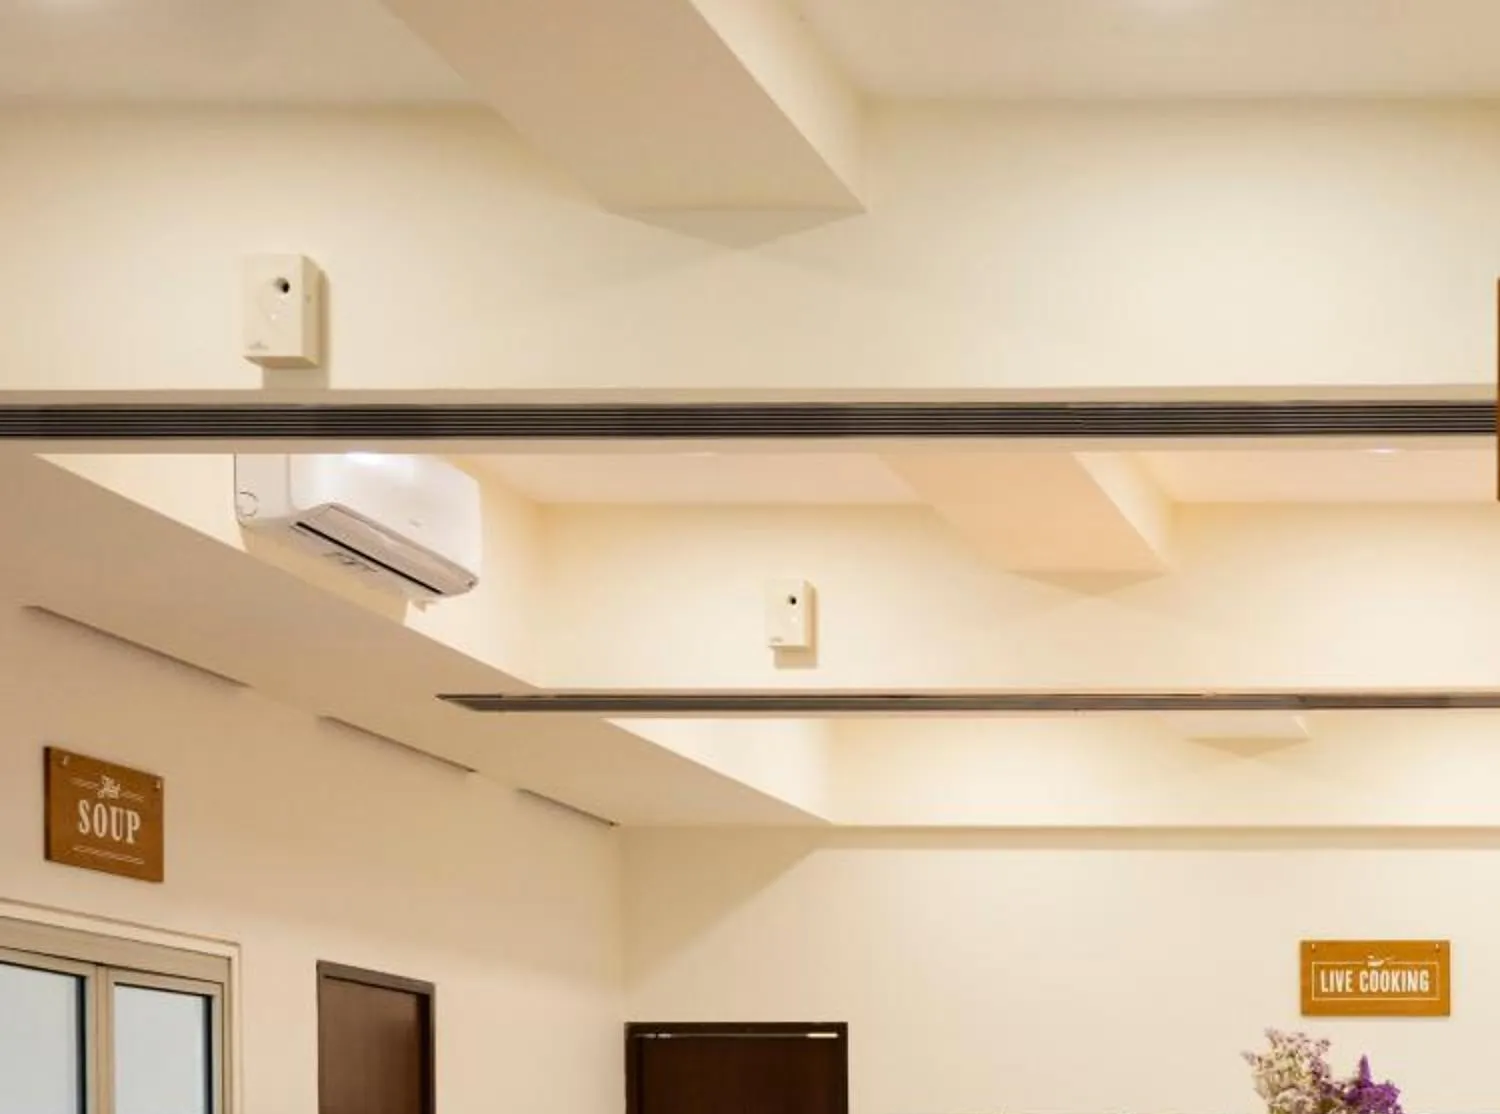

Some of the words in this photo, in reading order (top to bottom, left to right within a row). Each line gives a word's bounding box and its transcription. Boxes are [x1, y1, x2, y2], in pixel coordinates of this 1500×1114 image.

[78, 799, 141, 845] SOUP
[1320, 969, 1353, 993] LIVE
[1359, 969, 1429, 993] COOKING
